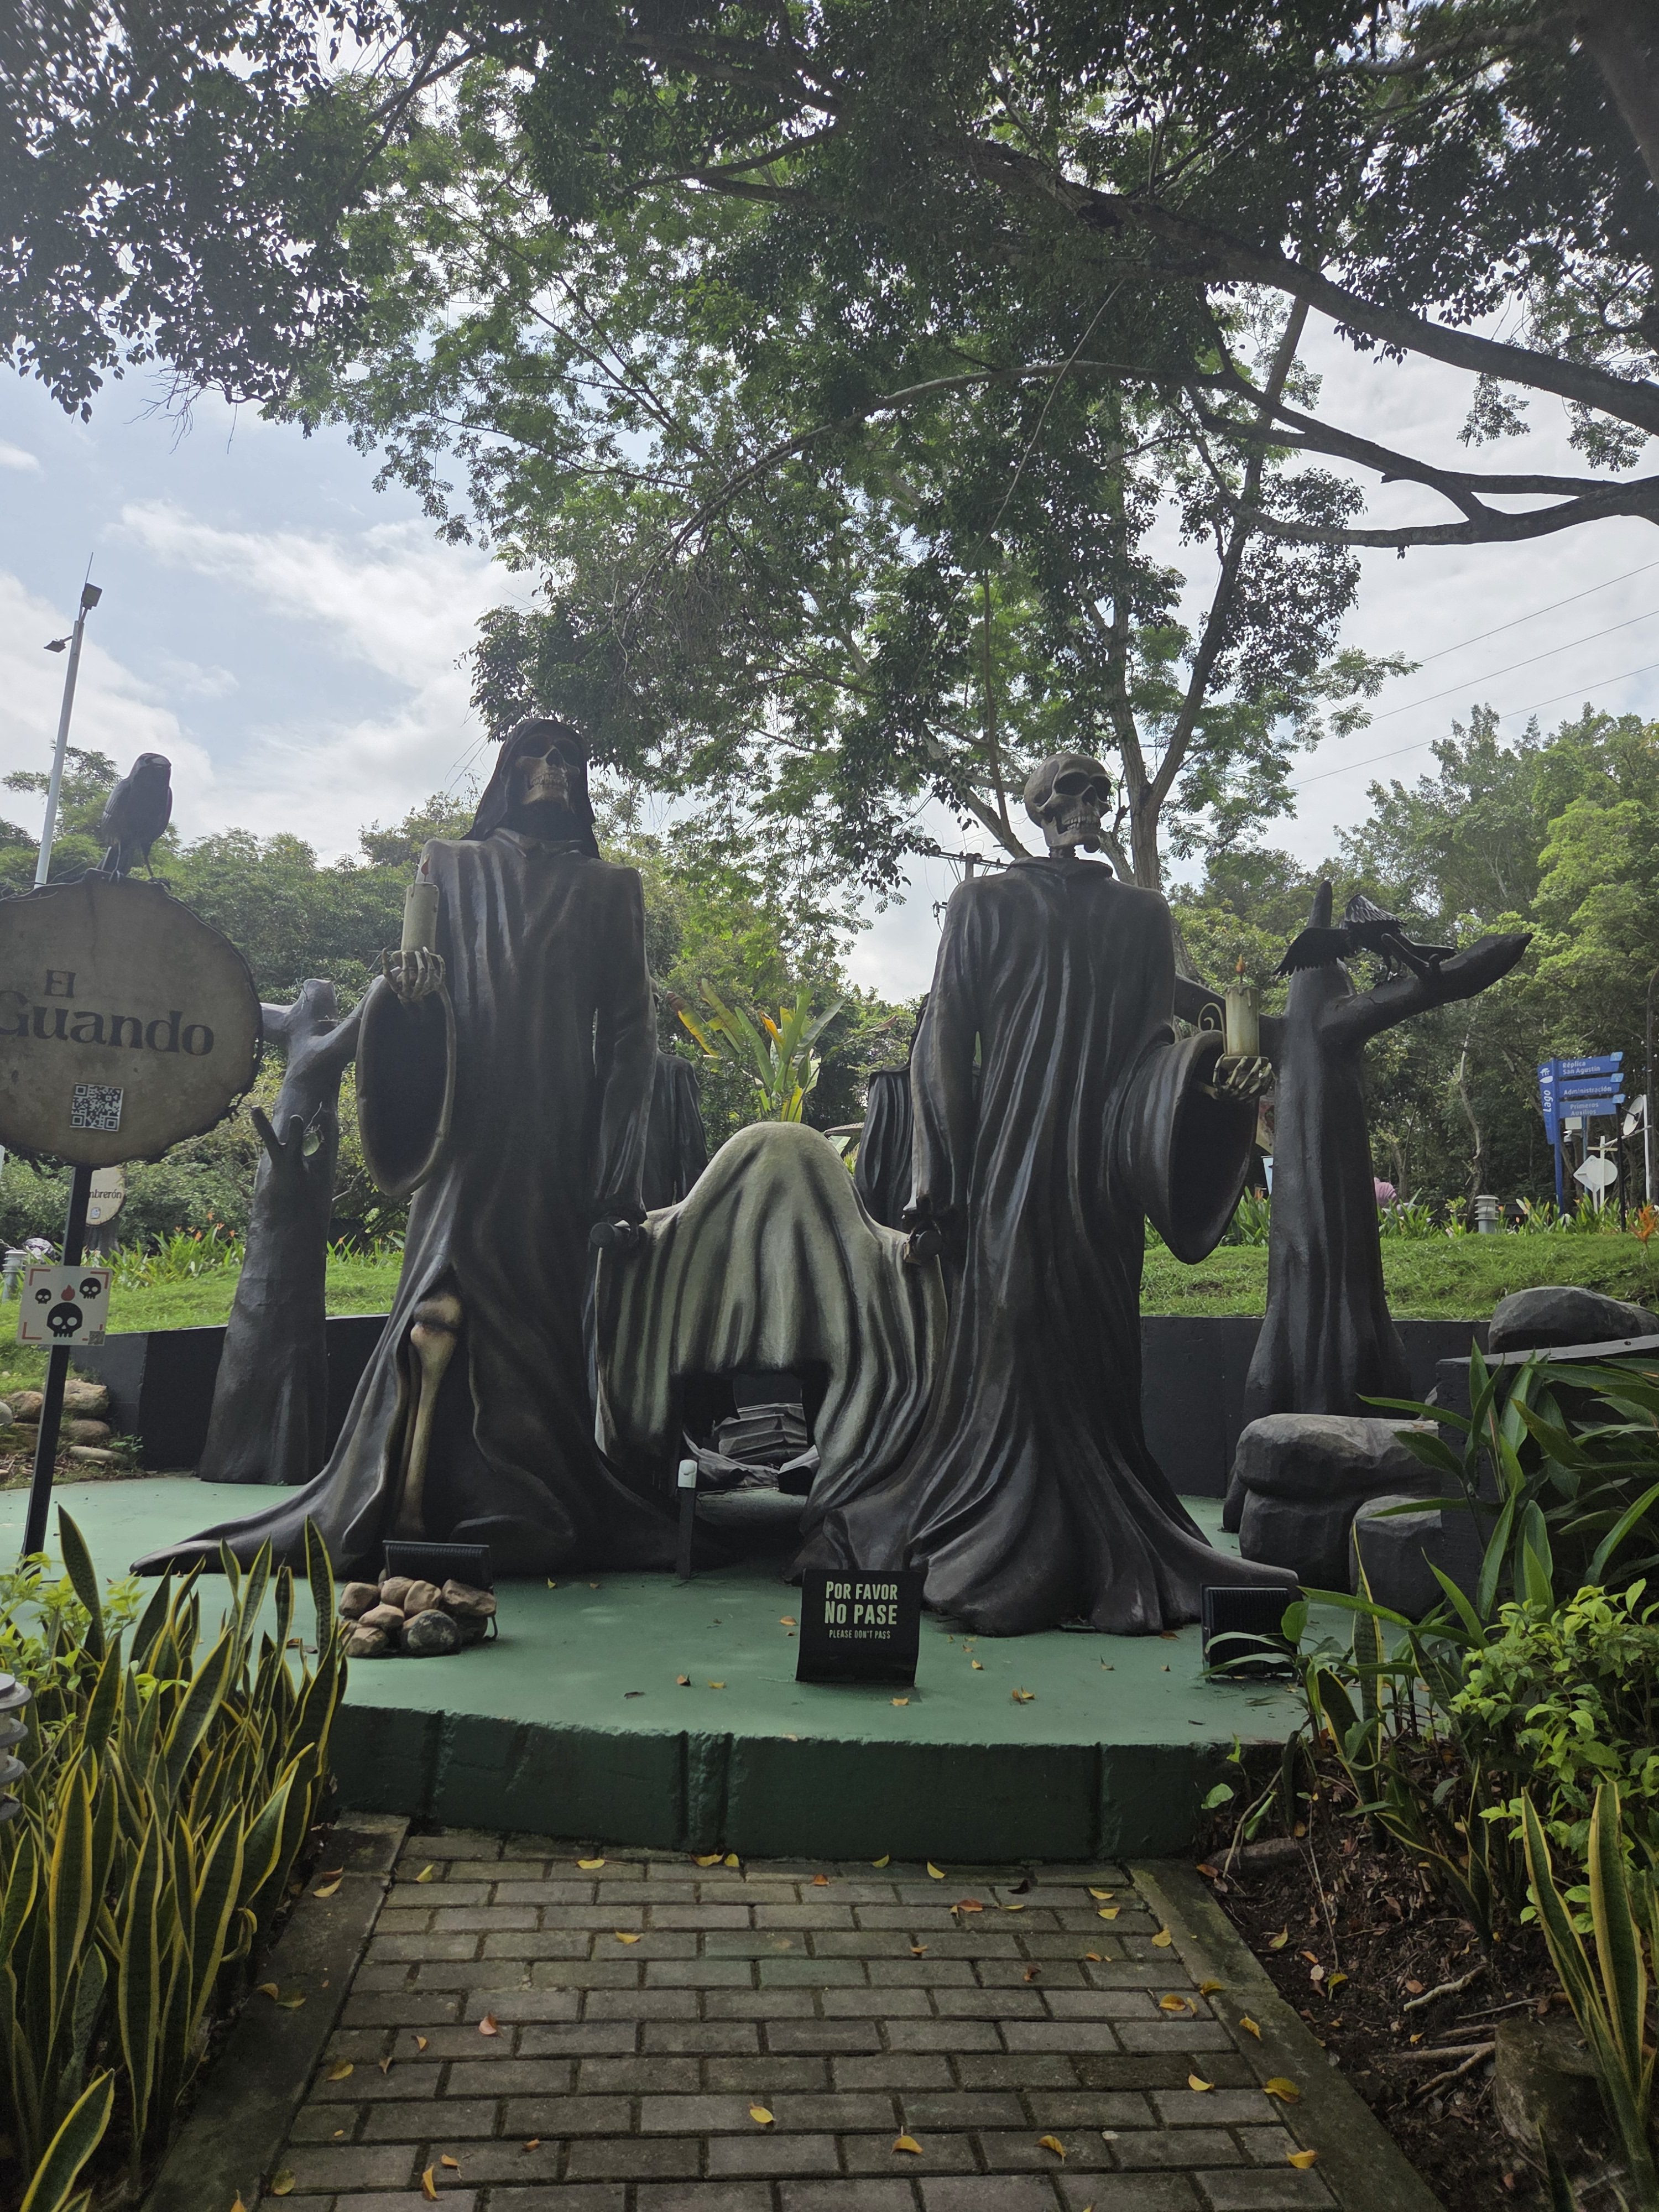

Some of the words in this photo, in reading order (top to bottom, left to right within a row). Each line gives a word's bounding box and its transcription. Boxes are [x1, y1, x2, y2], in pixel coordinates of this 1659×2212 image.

[0, 990, 215, 1056] Guando
[1564, 1086, 1612, 1095] Administración
[1542, 1090, 1553, 1113] Lago
[826, 1581, 851, 1599] POR
[855, 1584, 898, 1600] FAVOR
[825, 1601, 847, 1624] NO
[854, 1604, 898, 1625] PASE
[829, 1629, 852, 1639] PLEASE
[854, 1630, 873, 1639] DON'T
[875, 1630, 891, 1639] PASS
